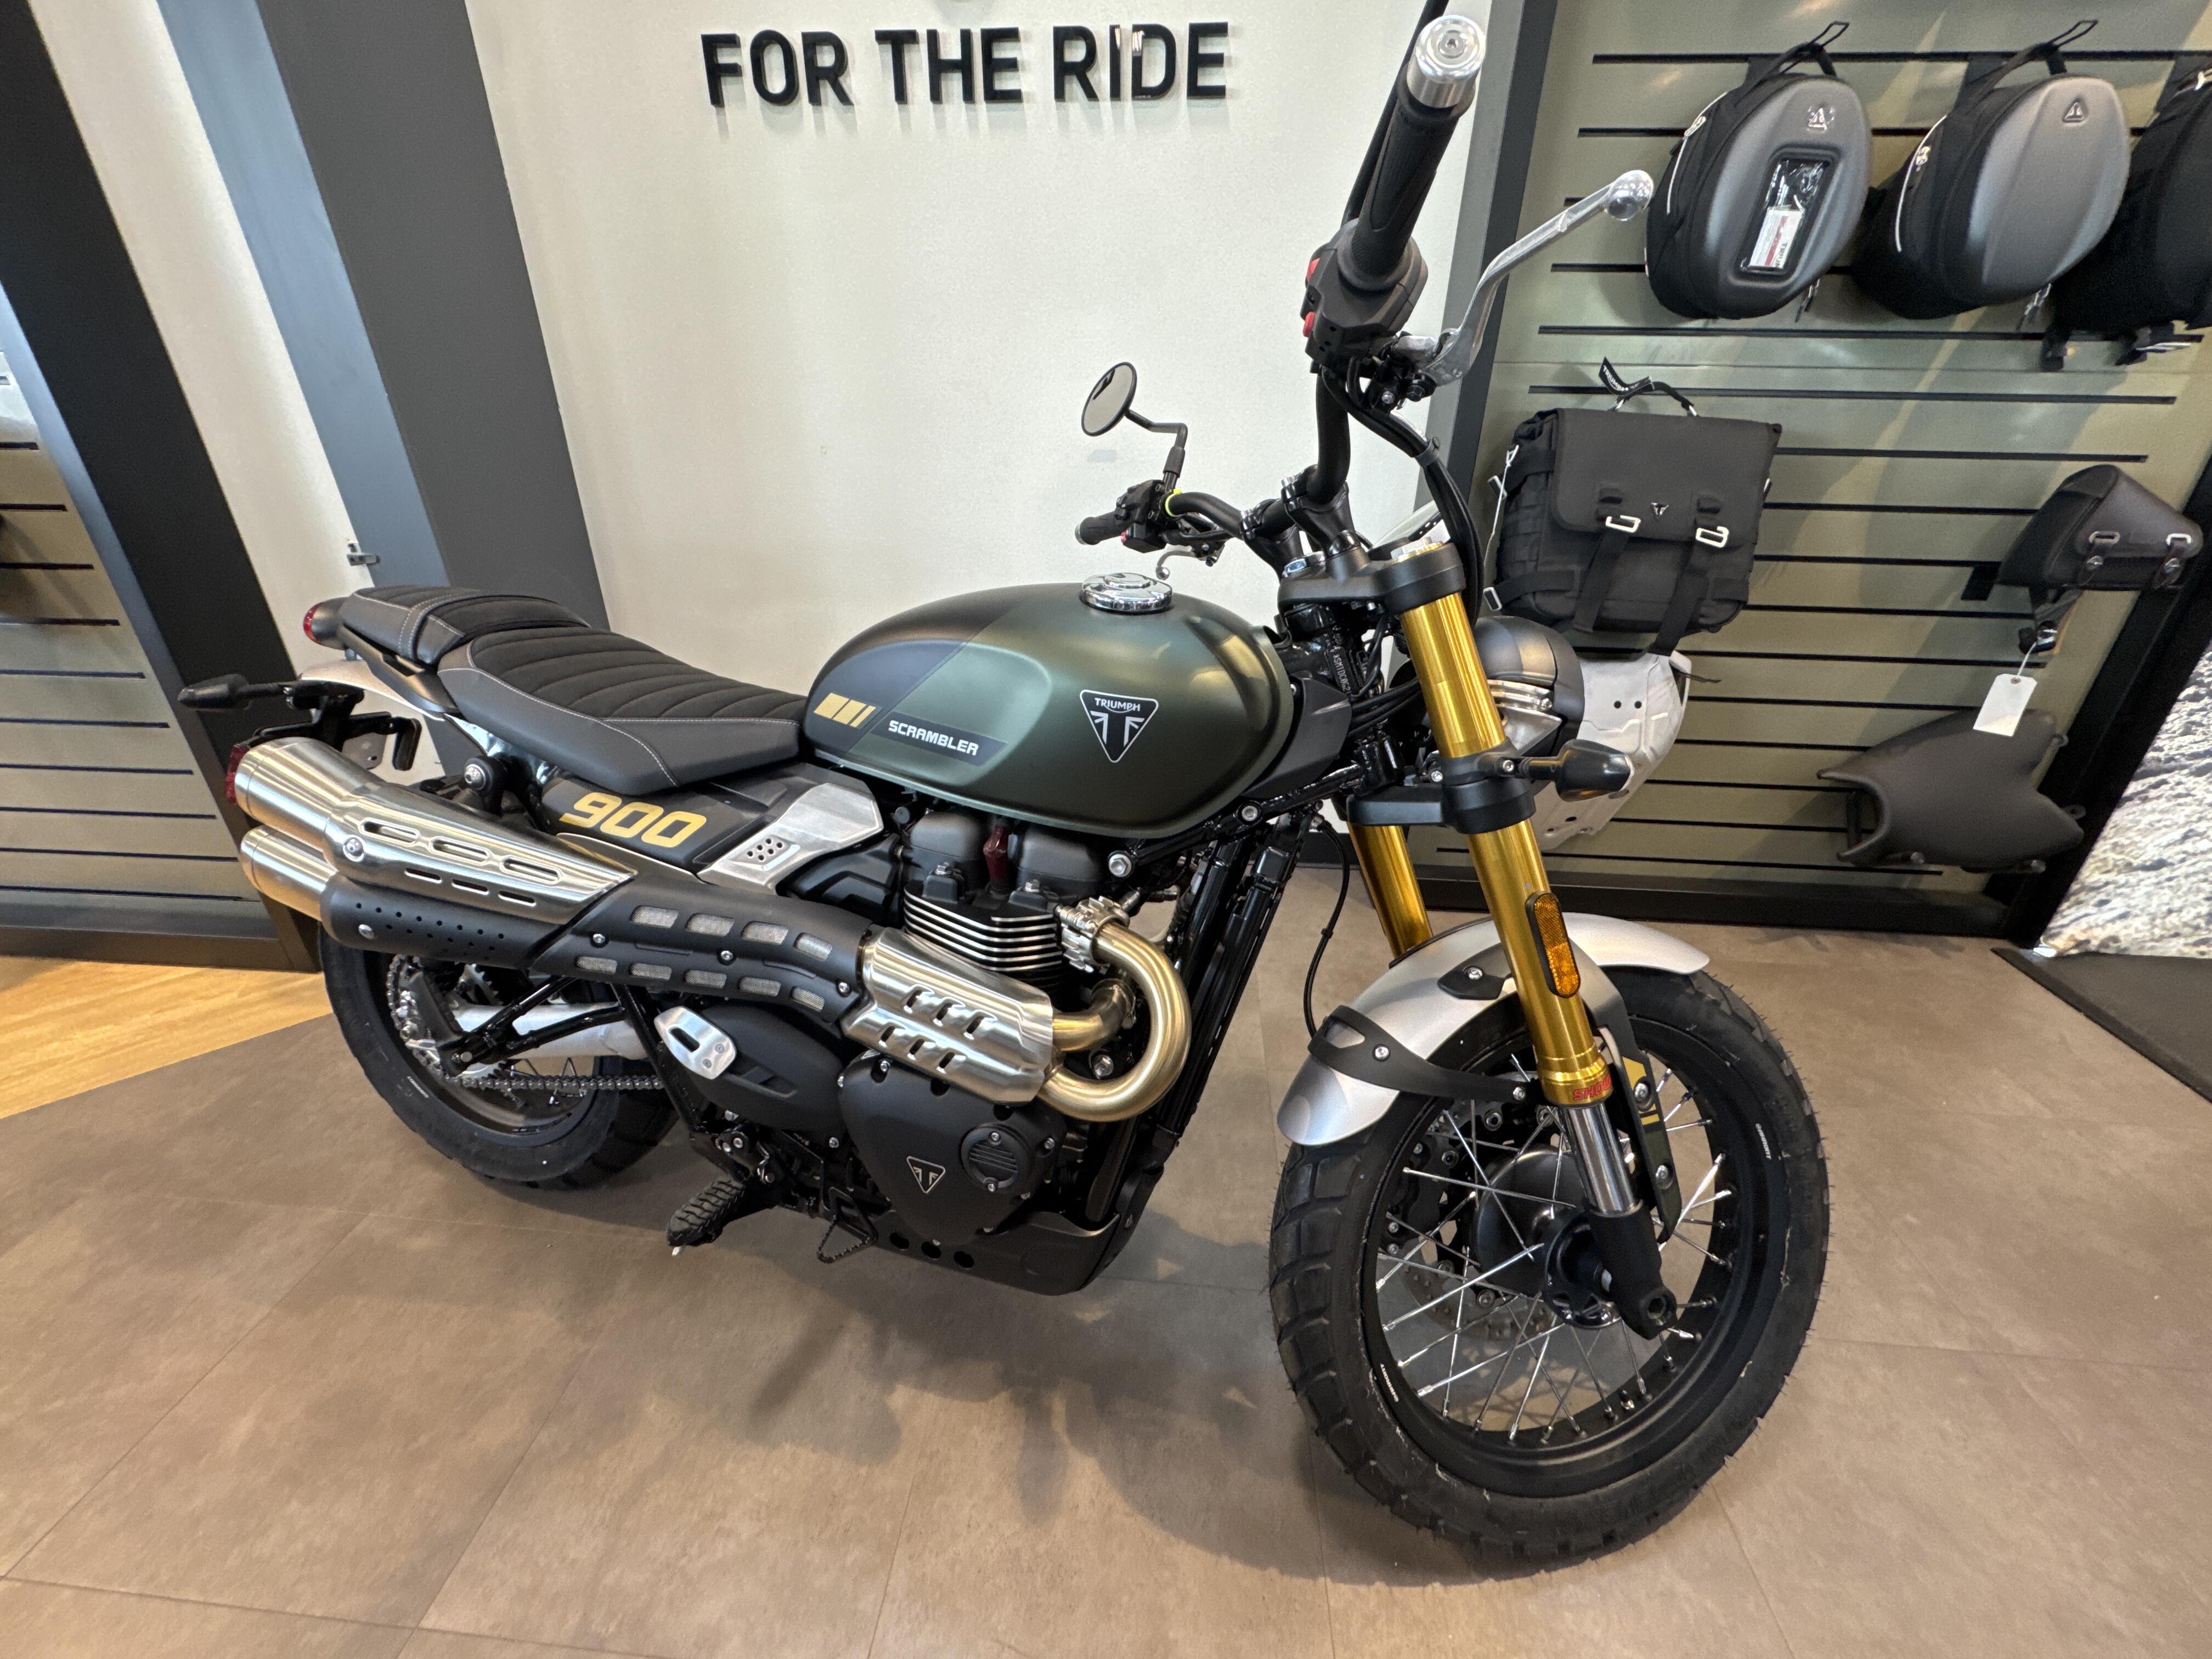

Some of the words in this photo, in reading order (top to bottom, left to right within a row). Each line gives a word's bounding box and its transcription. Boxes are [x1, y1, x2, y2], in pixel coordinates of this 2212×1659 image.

[701, 29, 854, 108] FOR
[874, 26, 1023, 105] THE
[1053, 21, 1229, 103] RIDE
[1094, 697, 1141, 712] TRIUMPH
[888, 720, 979, 756] SCRAMBLER
[558, 792, 707, 848] 900
